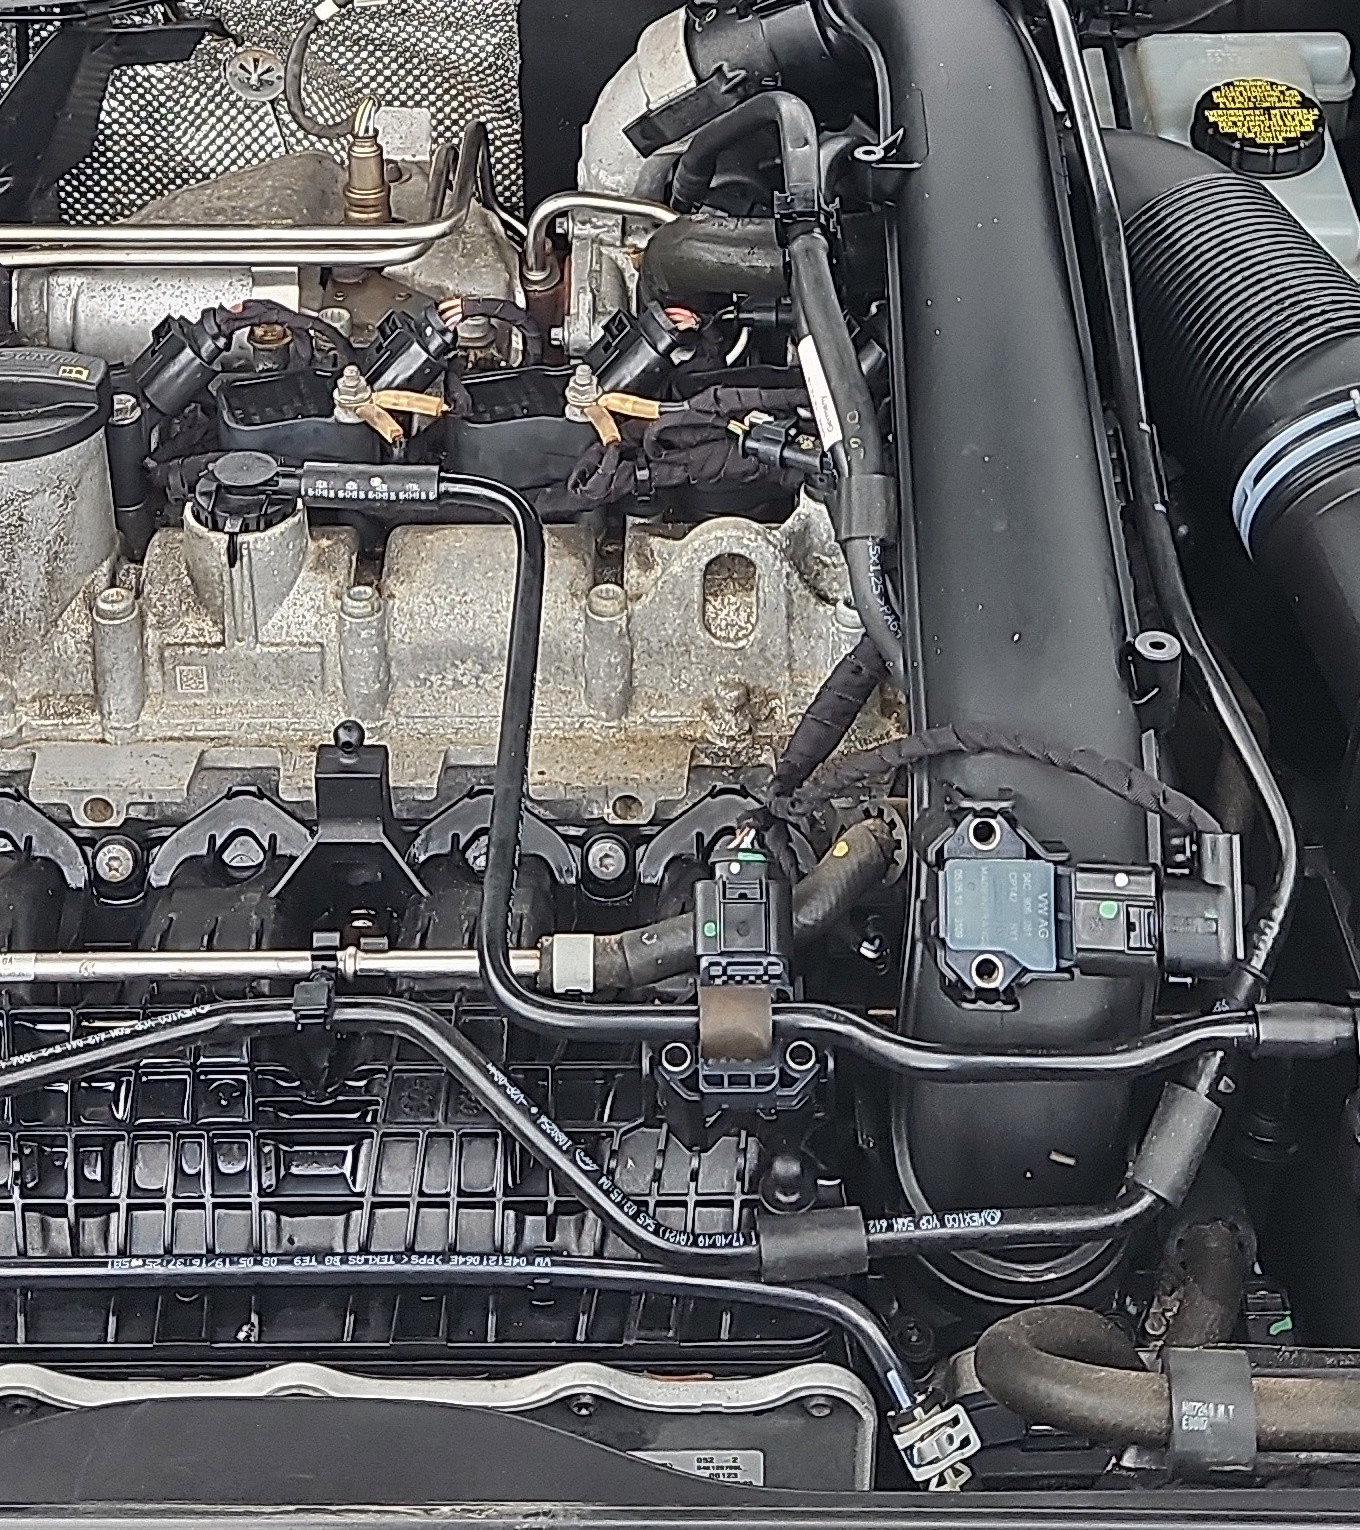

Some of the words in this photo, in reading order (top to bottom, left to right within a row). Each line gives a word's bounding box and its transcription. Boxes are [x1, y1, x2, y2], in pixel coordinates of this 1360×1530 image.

[1038, 892, 1048, 915] VW
[1038, 918, 1048, 938] AG
[348, 1255, 394, 1264] TEKLAS
